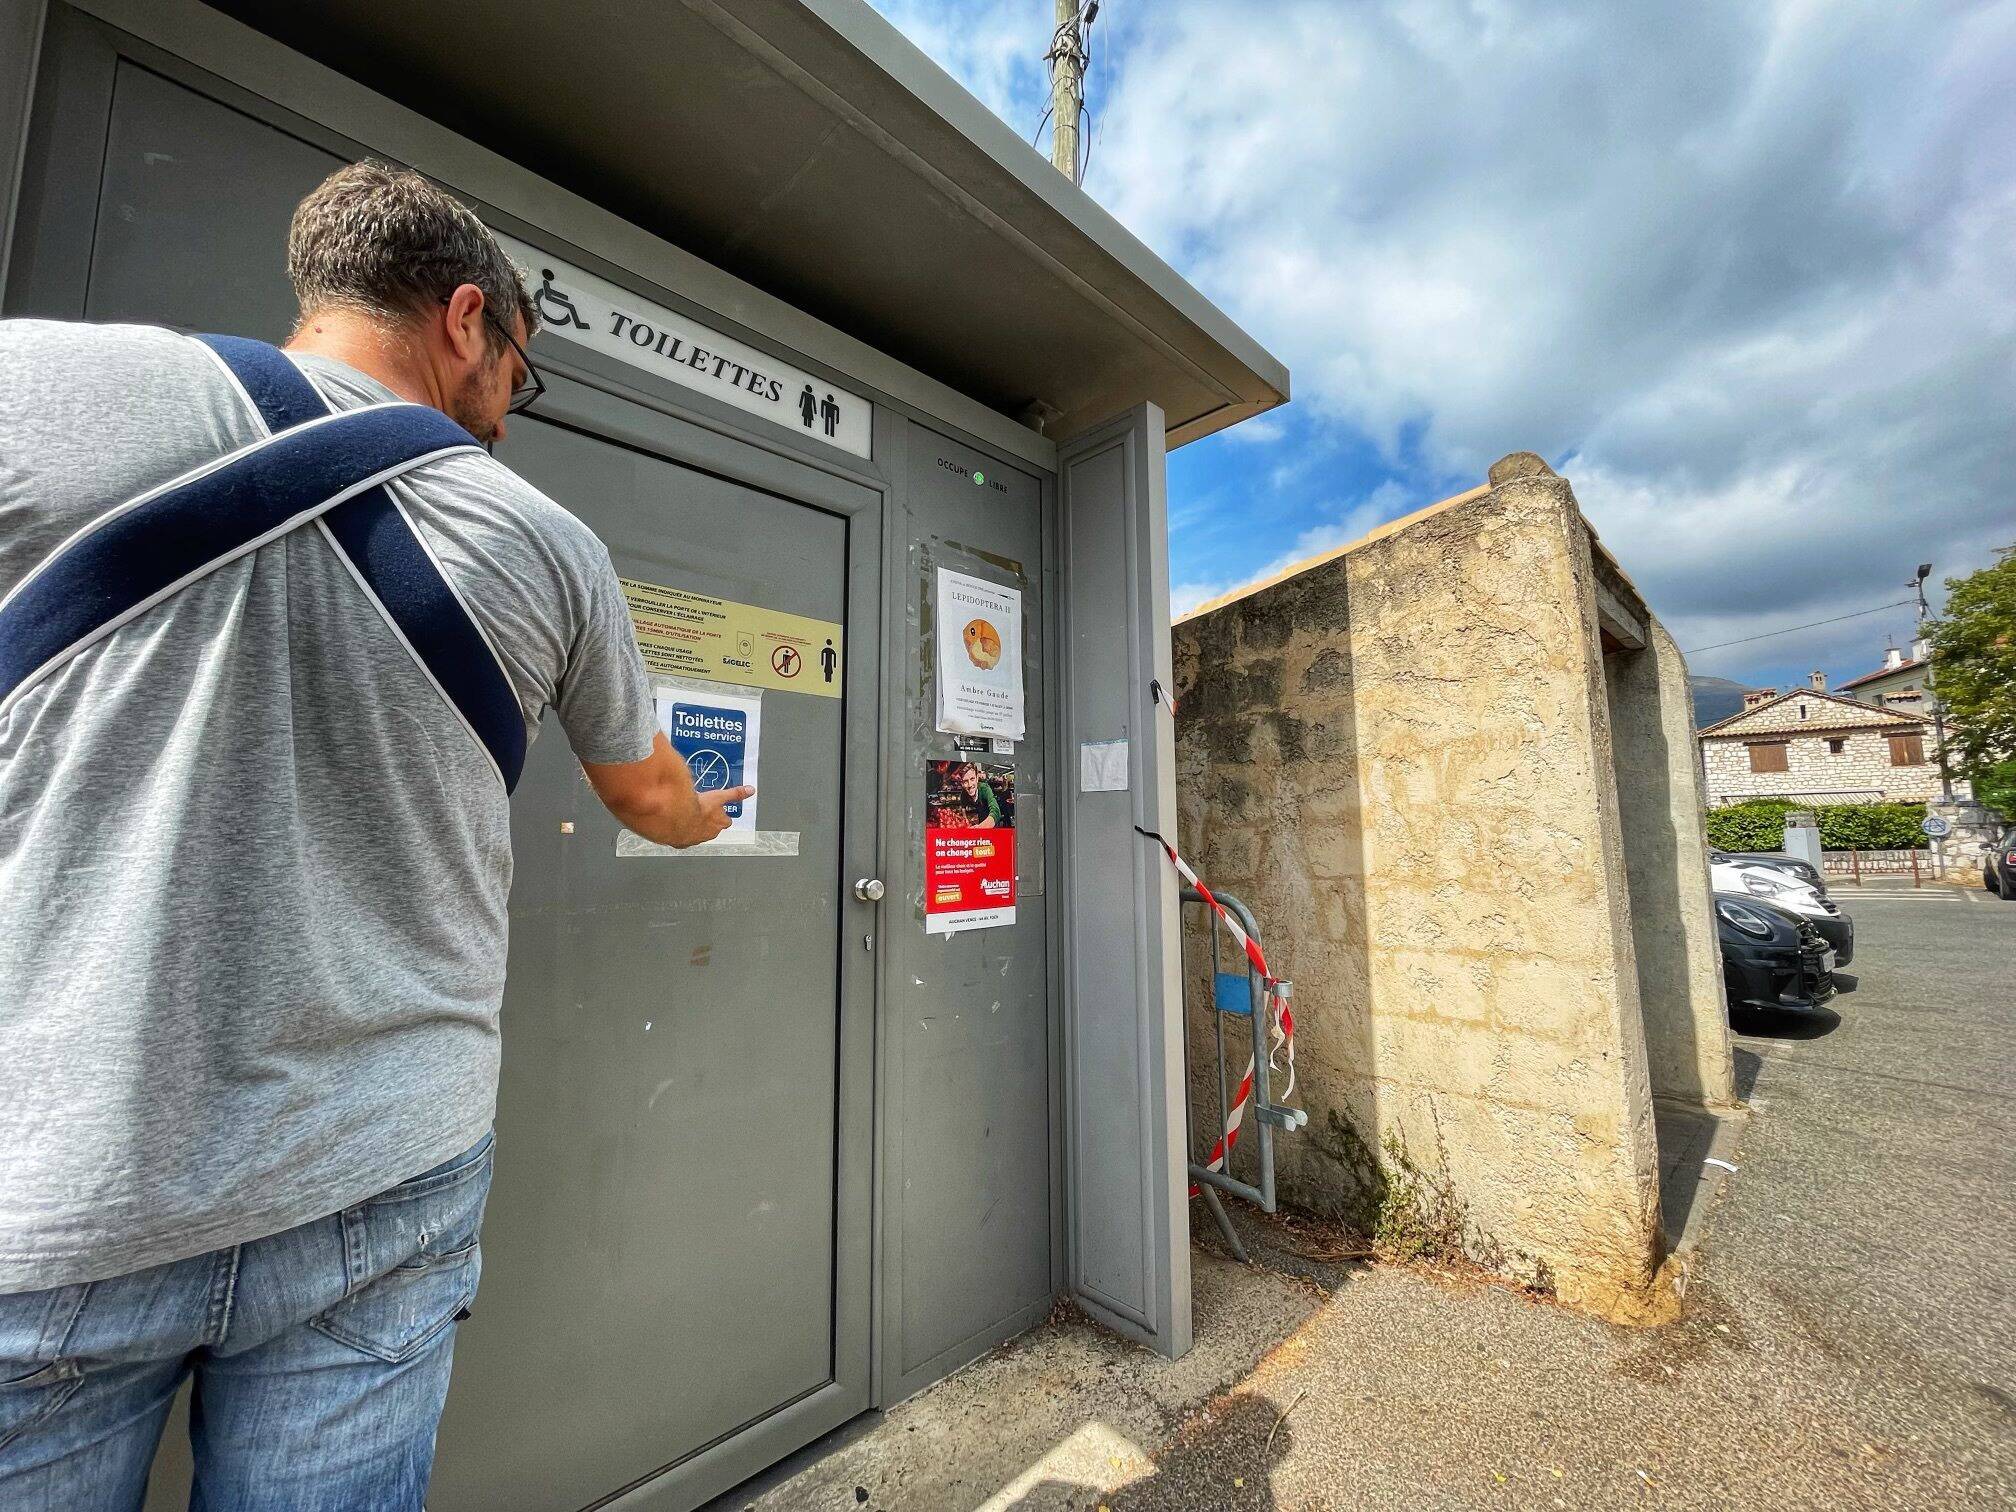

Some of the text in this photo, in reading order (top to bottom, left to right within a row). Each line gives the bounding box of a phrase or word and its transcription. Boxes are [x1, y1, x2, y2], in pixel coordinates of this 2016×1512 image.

[609, 312, 783, 402] TOILETTES
[938, 458, 968, 477] OCCUPE
[989, 480, 1008, 494] LIBRE
[638, 584, 658, 592] SOMME
[691, 596, 722, 606] MONNAYEUR
[952, 592, 1003, 611] LEPIDOPTERA
[631, 596, 666, 608] VERROUILLER
[674, 604, 690, 612] PORTE
[642, 606, 674, 616] CONSERVER
[654, 622, 692, 634] AUTOMATIQUE
[666, 630, 702, 640] D'UTILISATION
[654, 644, 674, 652] CHAQUE
[676, 647, 692, 655] USAGE
[660, 663, 711, 674] AUTOMATIQUEMENT
[960, 685, 1009, 700] Ambre Gaude
[676, 711, 743, 732] Toilettes
[676, 727, 742, 742] hors service
[936, 838, 946, 846] Ne
[947, 838, 976, 848] changez
[947, 848, 972, 858] change
[976, 848, 992, 856] tout.
[980, 878, 1010, 889] Auchan
[938, 894, 960, 902] ouvert
